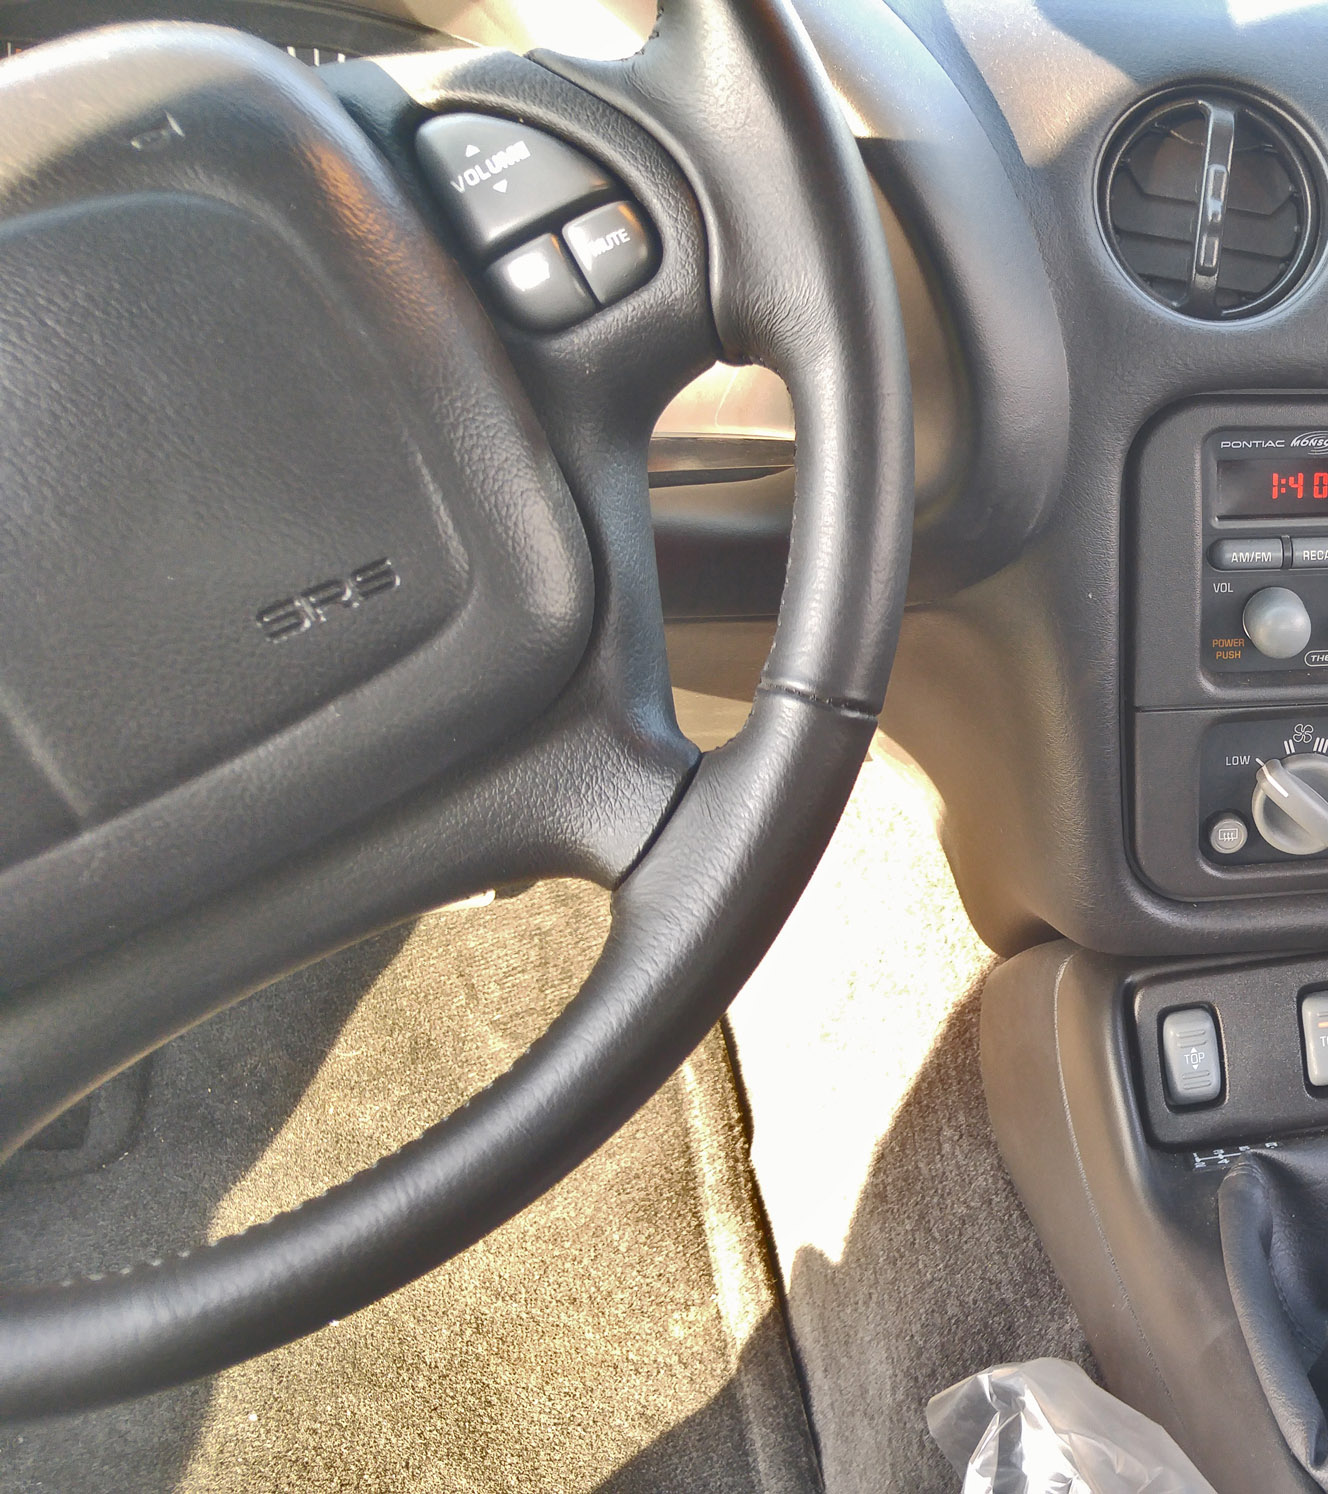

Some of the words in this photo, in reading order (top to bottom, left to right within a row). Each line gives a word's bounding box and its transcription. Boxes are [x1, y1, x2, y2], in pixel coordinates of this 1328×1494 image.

[591, 228, 631, 257] MUTE
[1220, 440, 1285, 449] PONTIAC
[1271, 472, 1328, 499] 1:40
[1231, 552, 1272, 563] AM/FM
[1213, 583, 1234, 593] VOL
[256, 556, 400, 643] SRS
[1212, 638, 1245, 648] POWER
[1216, 650, 1241, 660] PUSH
[1225, 756, 1251, 766] LOW
[1184, 1052, 1205, 1065] TOP
